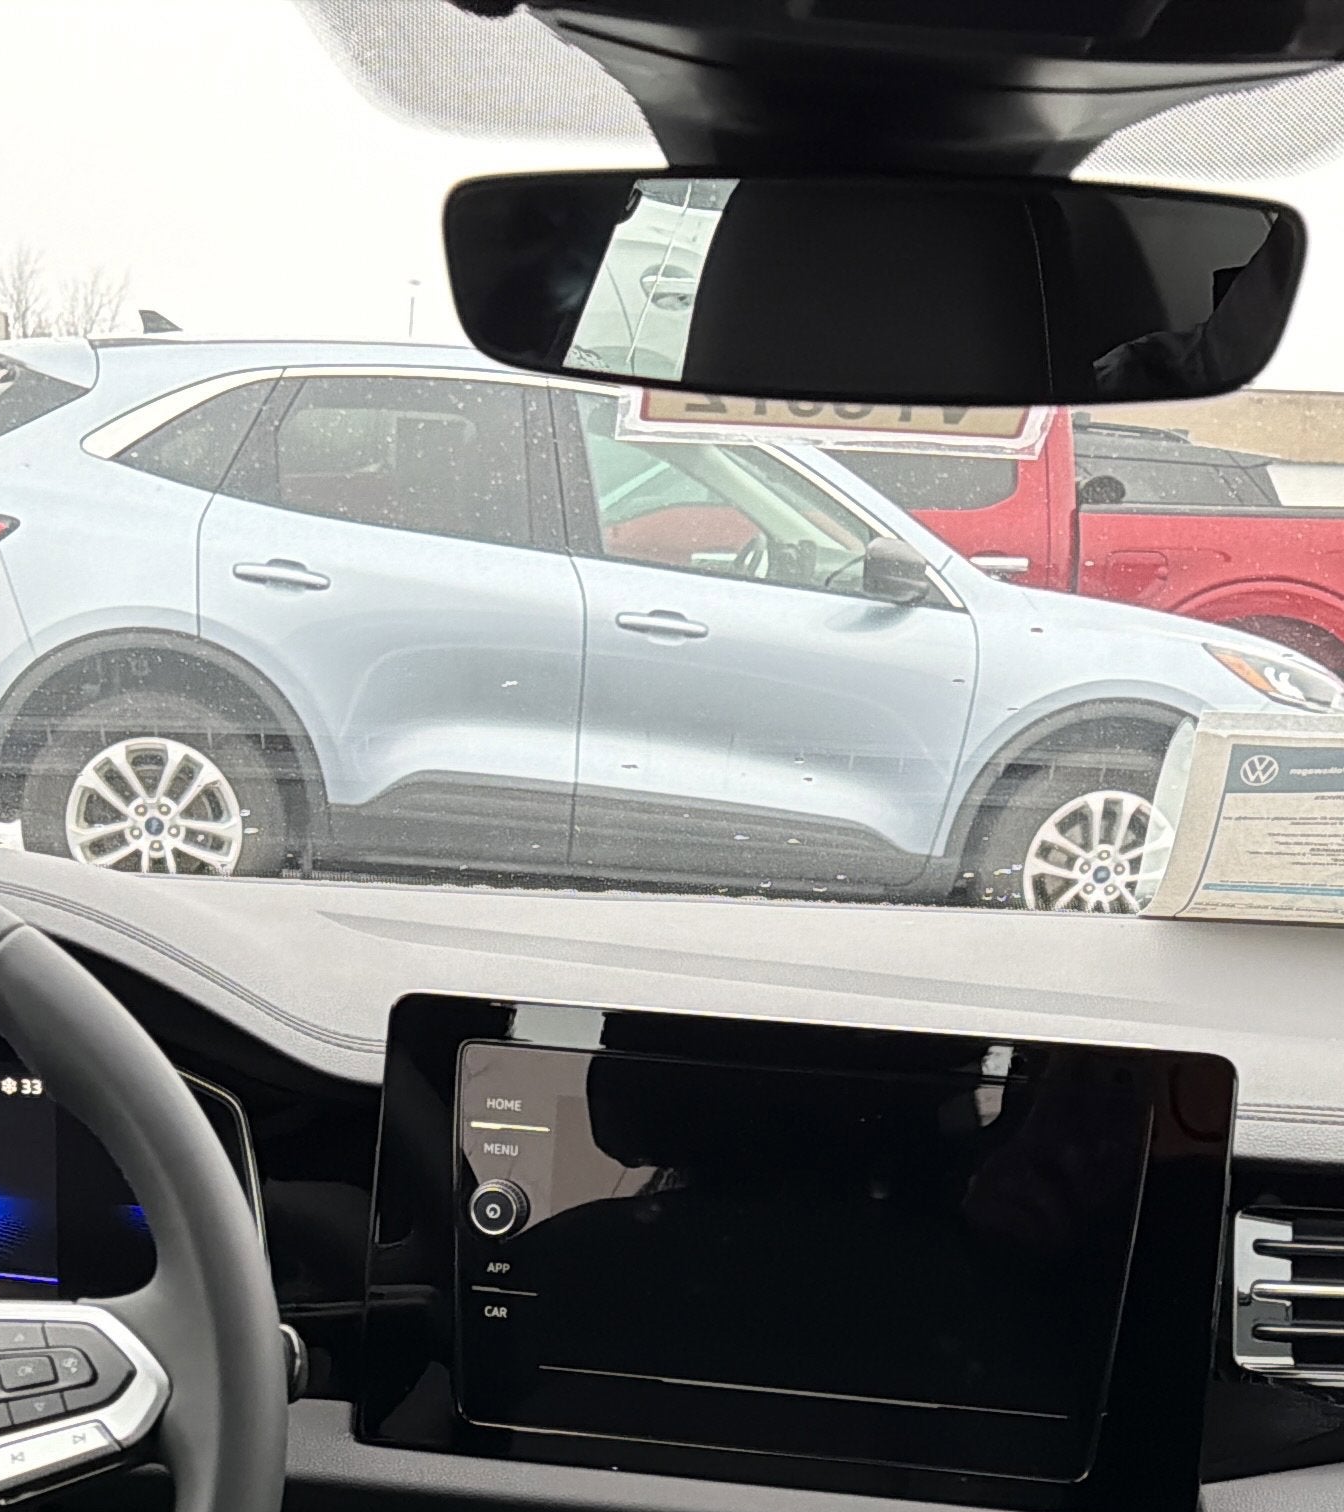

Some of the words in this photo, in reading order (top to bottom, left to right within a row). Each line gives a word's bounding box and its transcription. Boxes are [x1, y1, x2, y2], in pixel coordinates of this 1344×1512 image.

[20, 1078, 43, 1095] 33
[486, 1098, 522, 1112] HOME
[483, 1142, 519, 1157] MENU
[487, 1261, 511, 1274] APP
[484, 1305, 508, 1319] CAR
